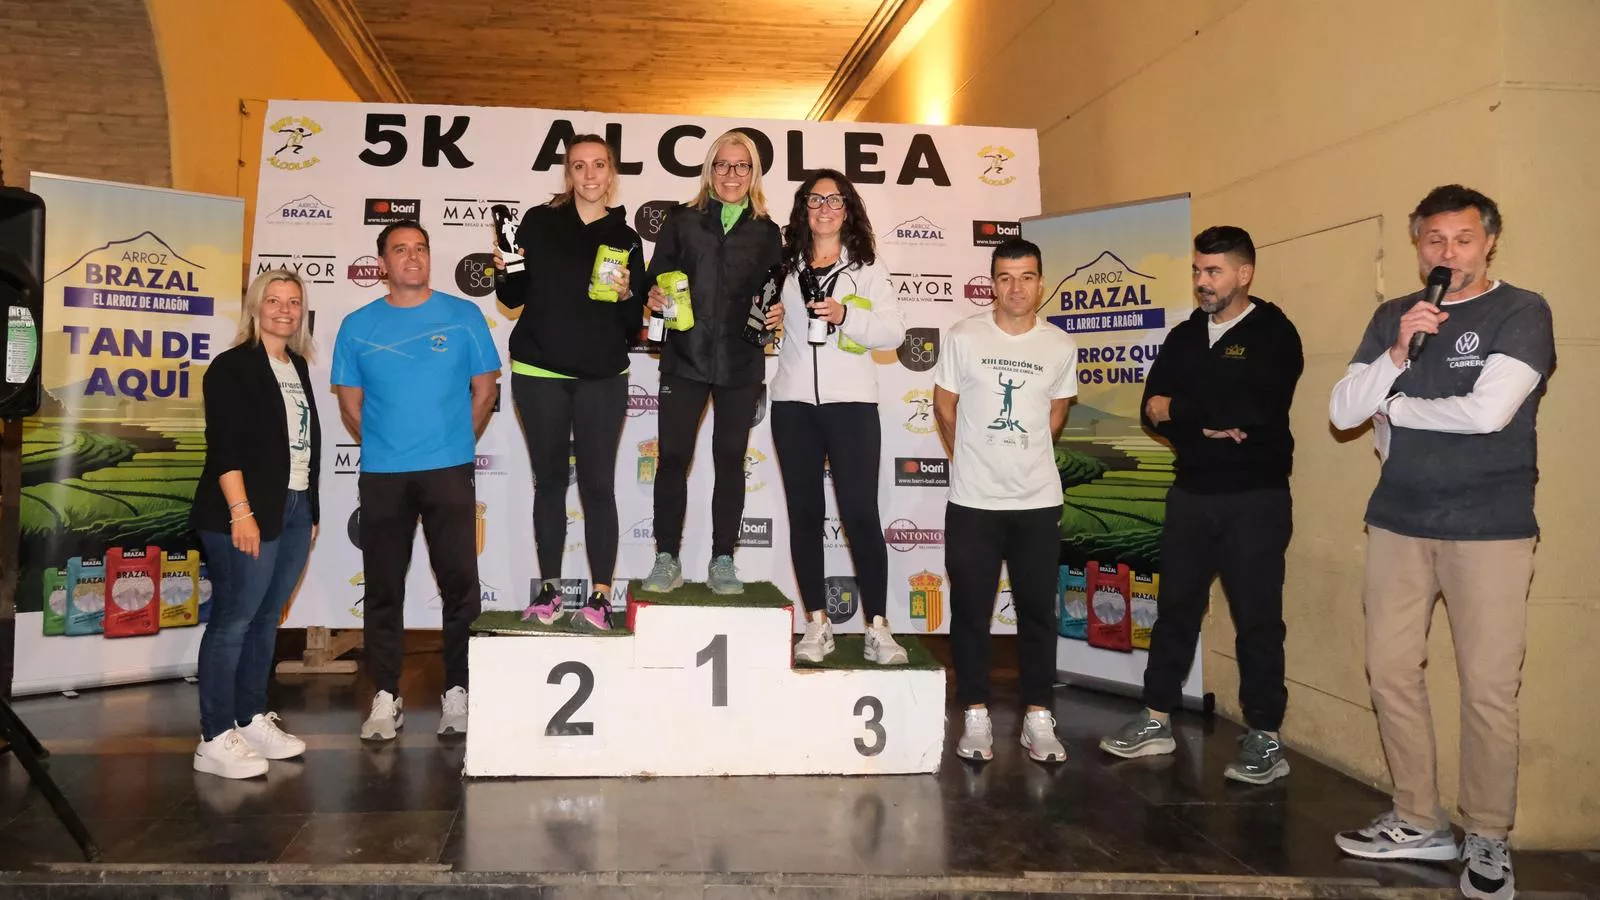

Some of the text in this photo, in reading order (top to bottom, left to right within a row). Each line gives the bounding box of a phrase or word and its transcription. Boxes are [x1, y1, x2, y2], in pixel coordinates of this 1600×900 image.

[358, 113, 475, 169] 5K
[282, 208, 333, 219] BRAZAL
[391, 202, 415, 214] barri
[443, 206, 519, 221] MAYR
[897, 229, 944, 239] BRAZAL
[997, 225, 1020, 236] barri
[121, 251, 168, 265] ARROZ
[85, 263, 199, 292] BRAZAL
[1087, 271, 1123, 286] ARROZ
[899, 281, 953, 296] AYOR
[93, 293, 189, 311] EL ARROZ DE ARAGÓN
[1060, 284, 1152, 311] BRAZAL
[1066, 312, 1144, 331] EL ARROZ DE ARAGÓN
[63, 326, 153, 357] TAN
[162, 332, 210, 361] DE
[1077, 344, 1164, 364] RROZ QU
[999, 359, 1032, 369] EDICIÓN
[1034, 364, 1044, 373] 5K
[84, 360, 190, 402] AQUÍ
[1107, 367, 1144, 384] UNE
[921, 461, 944, 473] barri
[743, 521, 767, 534] barri
[893, 531, 942, 541] ANTONIO
[116, 571, 150, 579] BRAZAL
[1065, 584, 1086, 592] BRAZA
[1131, 592, 1157, 600] BRAZAL
[696, 634, 728, 707] 1
[544, 661, 595, 736] 2
[853, 695, 887, 756] 3
